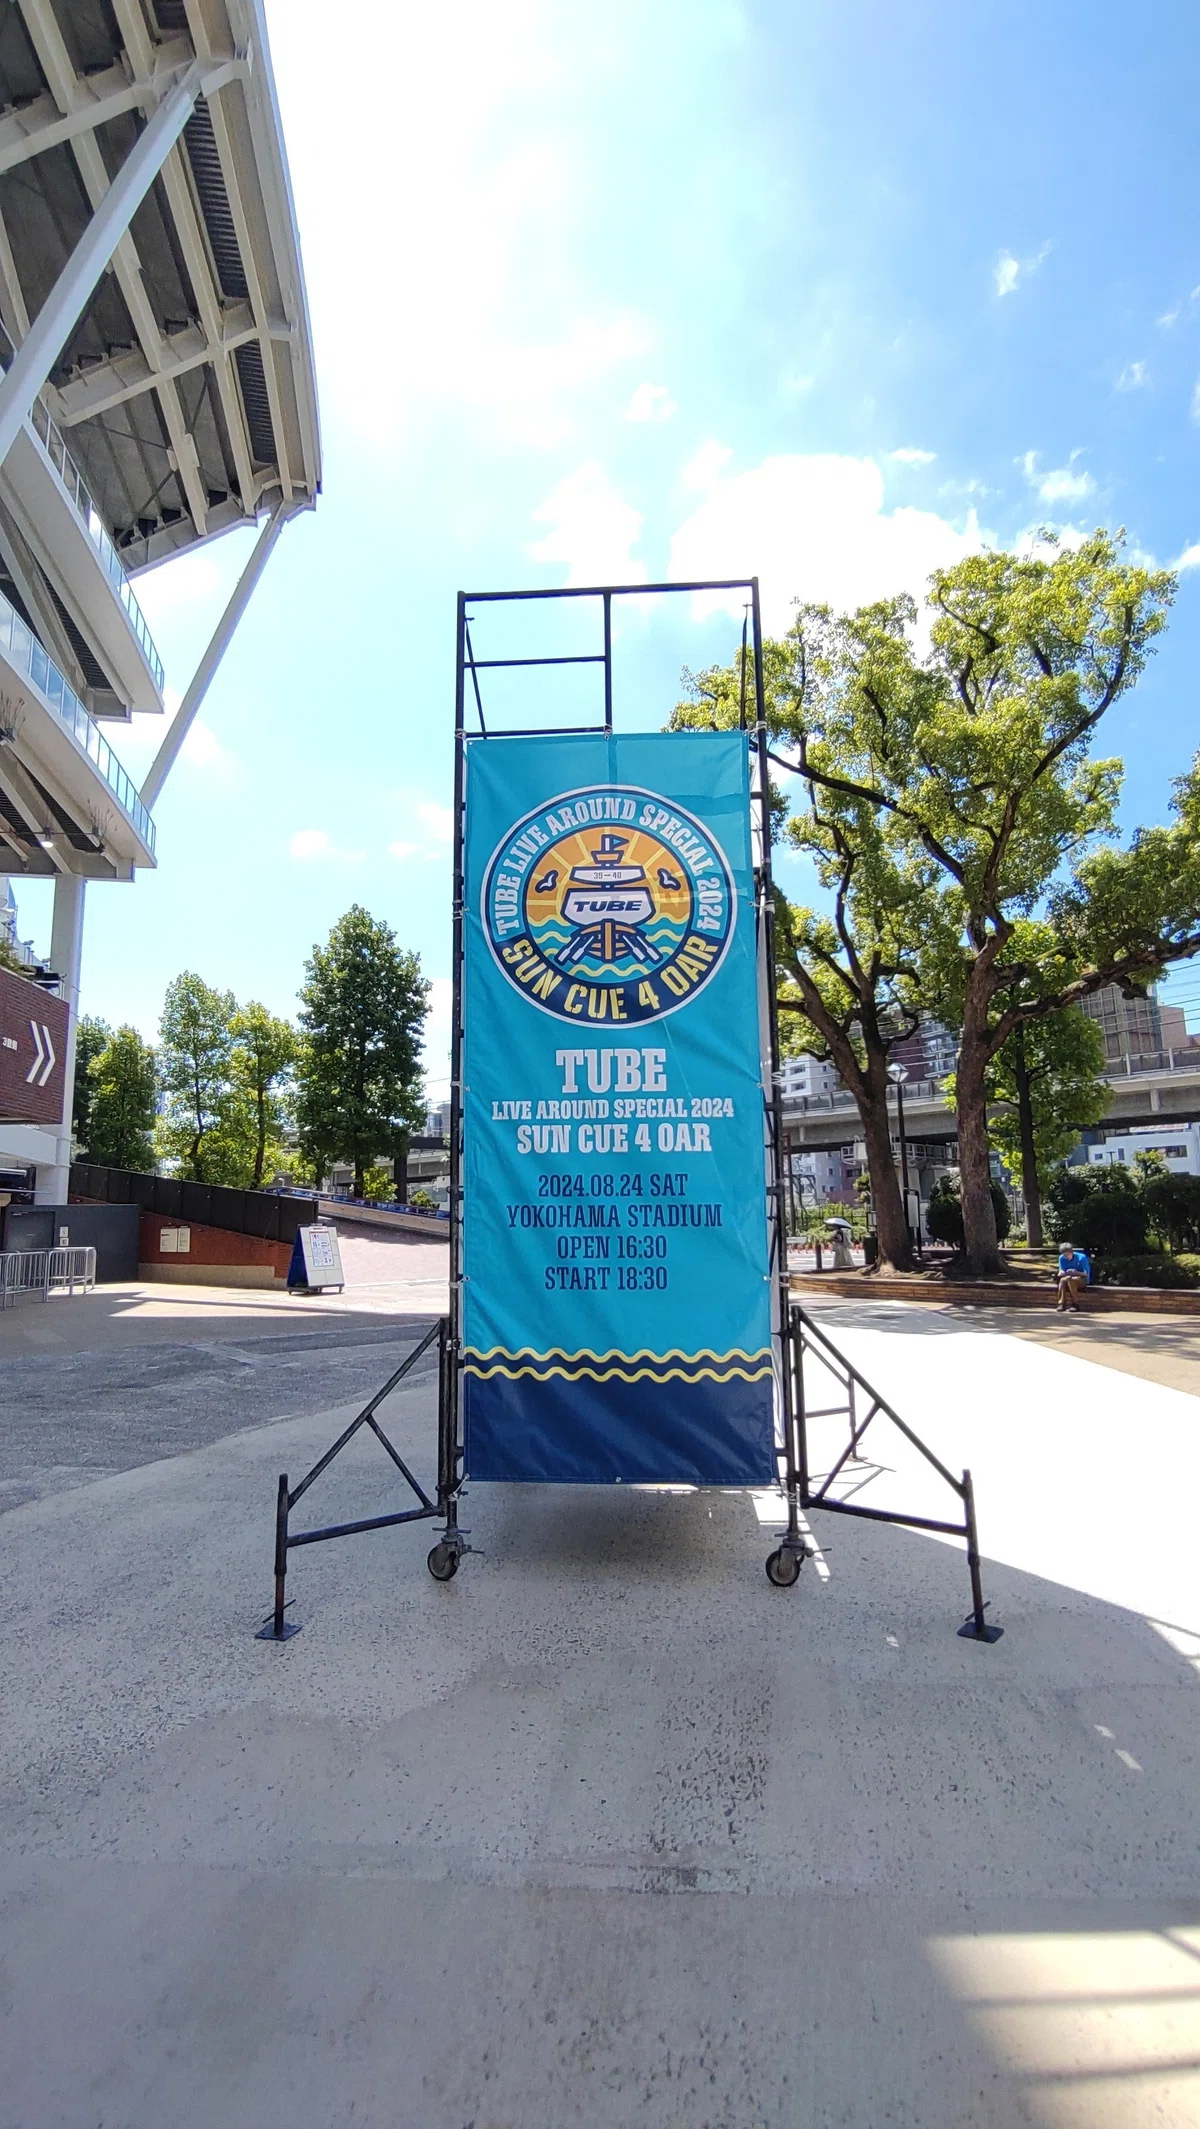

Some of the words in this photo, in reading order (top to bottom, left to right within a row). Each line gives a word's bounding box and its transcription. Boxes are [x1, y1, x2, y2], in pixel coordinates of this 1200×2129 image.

[546, 797, 636, 836] AROUND
[503, 824, 550, 874] LIVE
[639, 804, 714, 877] SPECIAL
[494, 873, 522, 935] TUBE
[573, 900, 642, 912] TUBE
[696, 877, 723, 931] 2024
[502, 938, 562, 1000] SUN
[563, 983, 628, 1020] CUE
[639, 980, 660, 1010] 4
[660, 935, 719, 997] OAR
[555, 1048, 667, 1093] TUBE
[492, 1101, 532, 1120] LIVE
[535, 1099, 609, 1120] AROUND
[613, 1098, 688, 1119] SPECIAL
[691, 1097, 735, 1118] 2024
[517, 1124, 571, 1154] SUN
[578, 1123, 628, 1154] CUE
[634, 1123, 651, 1152] 4
[657, 1123, 712, 1152] OAR
[538, 1174, 643, 1198] 2024.08.24
[650, 1173, 689, 1197] SAT
[506, 1204, 620, 1228] YOKOHAMA
[627, 1203, 723, 1227] STADIUM
[557, 1235, 610, 1260] OPEN
[617, 1234, 667, 1258] 16:30
[544, 1266, 610, 1291] START
[617, 1266, 668, 1290] 18:30
